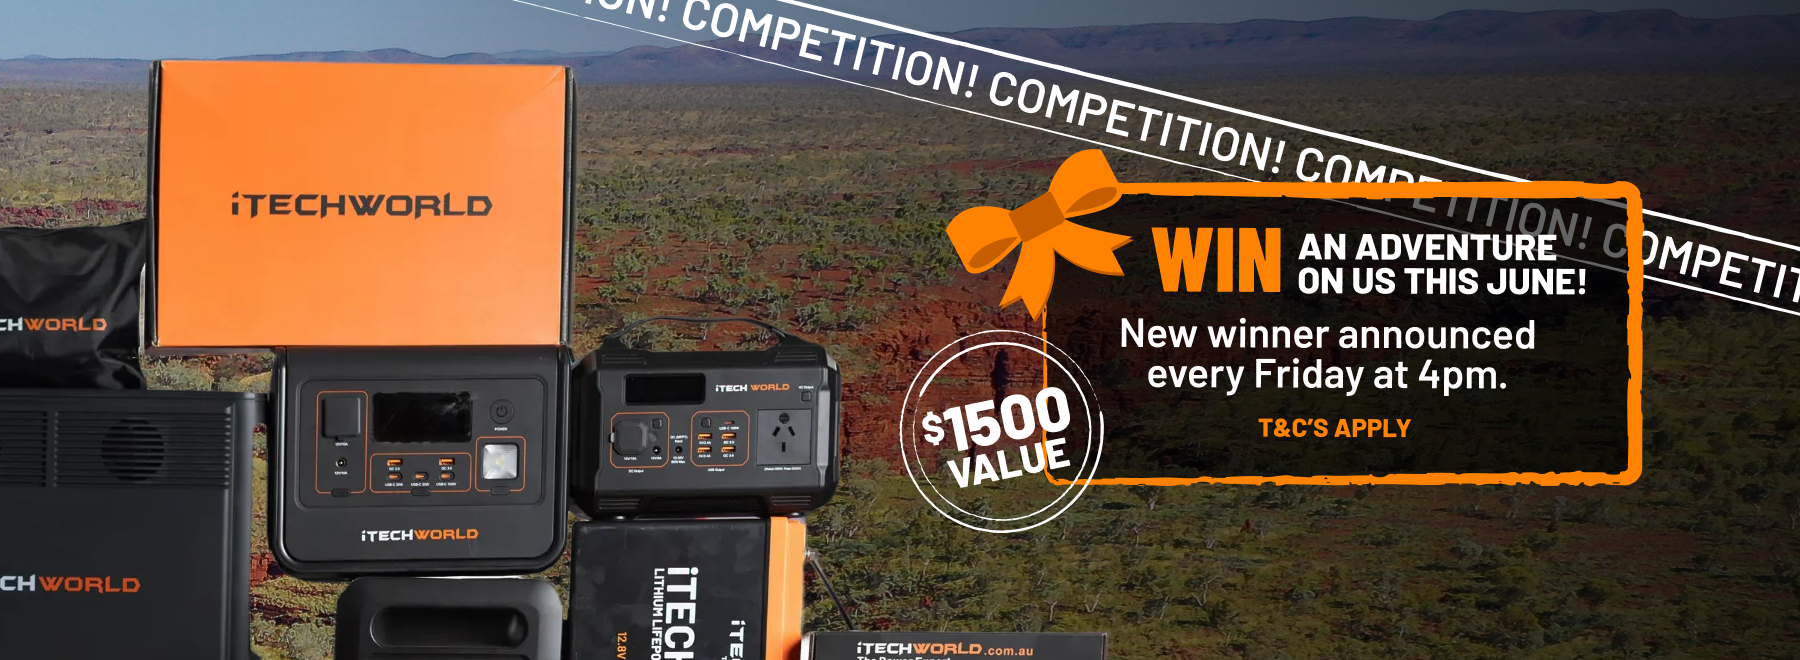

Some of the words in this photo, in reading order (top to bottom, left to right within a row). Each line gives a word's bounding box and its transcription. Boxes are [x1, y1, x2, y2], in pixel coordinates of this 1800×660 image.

[231, 191, 493, 219] iTECHWORLD
[715, 383, 749, 393] iTECH
[750, 383, 791, 392] WORLD
[361, 527, 479, 543] iTECHWORLD
[652, 567, 666, 617] LITHIUM
[729, 620, 746, 660] iTE
